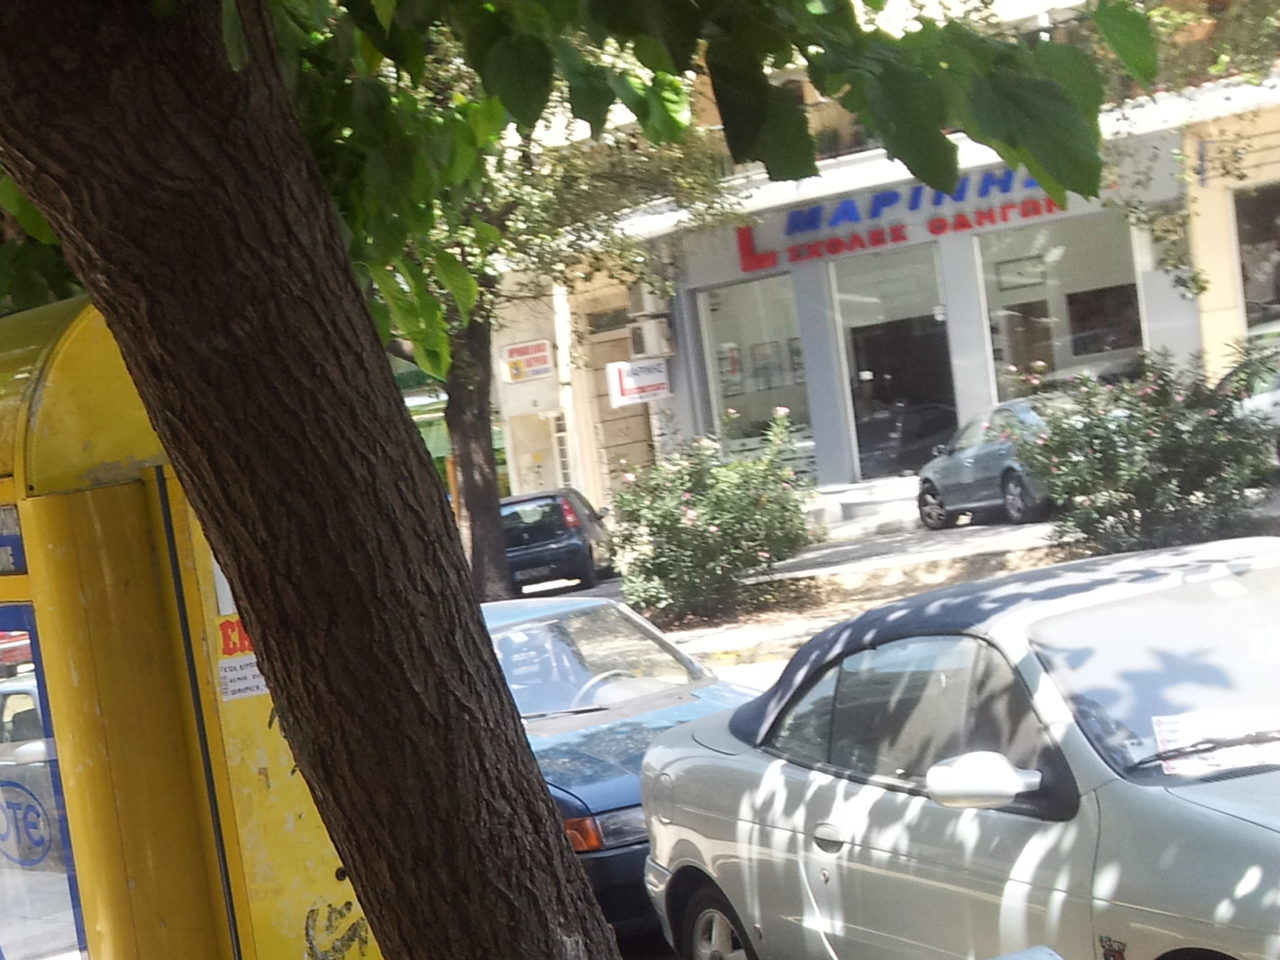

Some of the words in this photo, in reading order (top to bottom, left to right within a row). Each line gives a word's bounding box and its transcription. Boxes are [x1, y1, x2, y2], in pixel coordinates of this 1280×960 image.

[785, 168, 1040, 236] ΜΑΡΙΝΗ
[737, 226, 778, 273] L
[787, 223, 909, 264] ΣΧΟΛΕΣ
